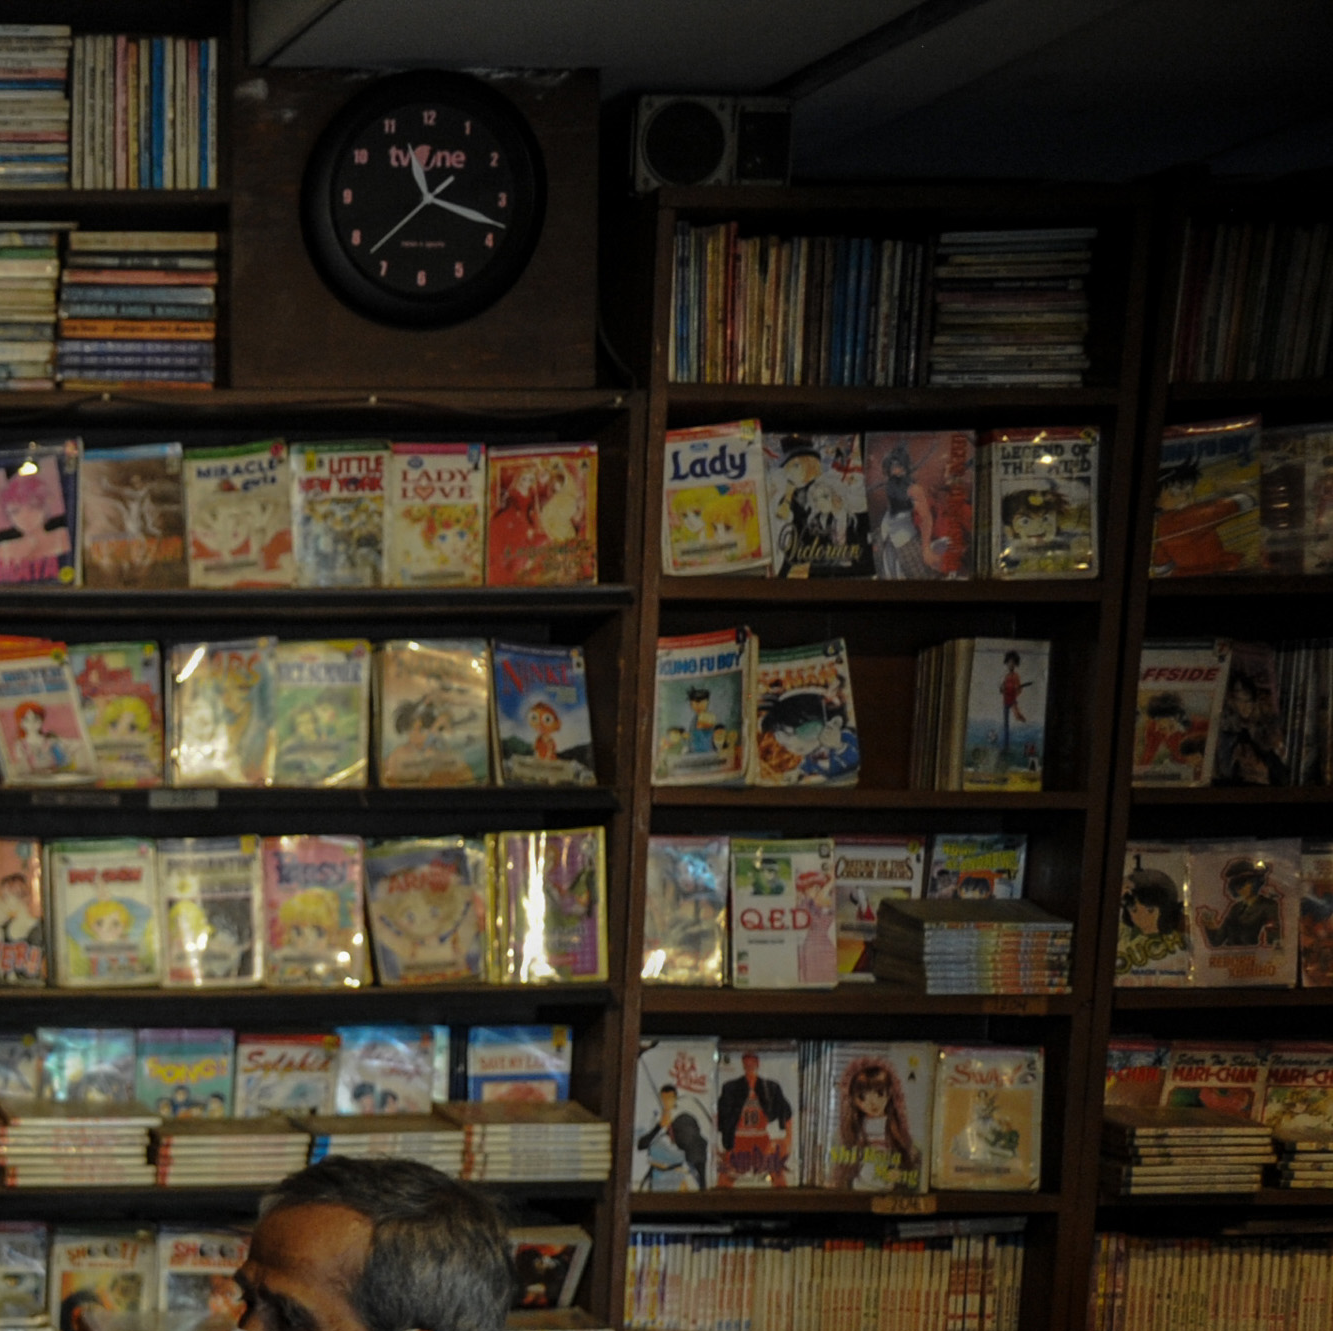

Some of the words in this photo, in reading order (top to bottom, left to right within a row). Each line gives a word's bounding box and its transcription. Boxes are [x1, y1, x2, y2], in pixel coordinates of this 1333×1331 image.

[383, 119, 396, 133] 11
[422, 110, 437, 126] 12
[464, 121, 472, 134] 1
[353, 149, 369, 165] 10
[489, 152, 499, 167] 2
[342, 188, 353, 205] 9
[497, 192, 507, 208] 3
[351, 229, 361, 246] 8
[484, 233, 494, 249] 4
[379, 260, 388, 277] 7
[454, 261, 464, 278] 5
[416, 270, 427, 286] 6
[196, 457, 278, 480] MIRACLE
[329, 456, 384, 476] LITTLE
[670, 445, 747, 482] Lady
[401, 468, 473, 484] LADY
[659, 659, 697, 675] KUNG
[699, 655, 716, 671] FU
[718, 652, 741, 669] BOY
[1141, 667, 1222, 682] FFSIDE
[1114, 932, 1184, 975] OUCH
[1172, 1066, 1259, 1083] MARI-CHAN
[1267, 1066, 1333, 1085] MARI-CH
